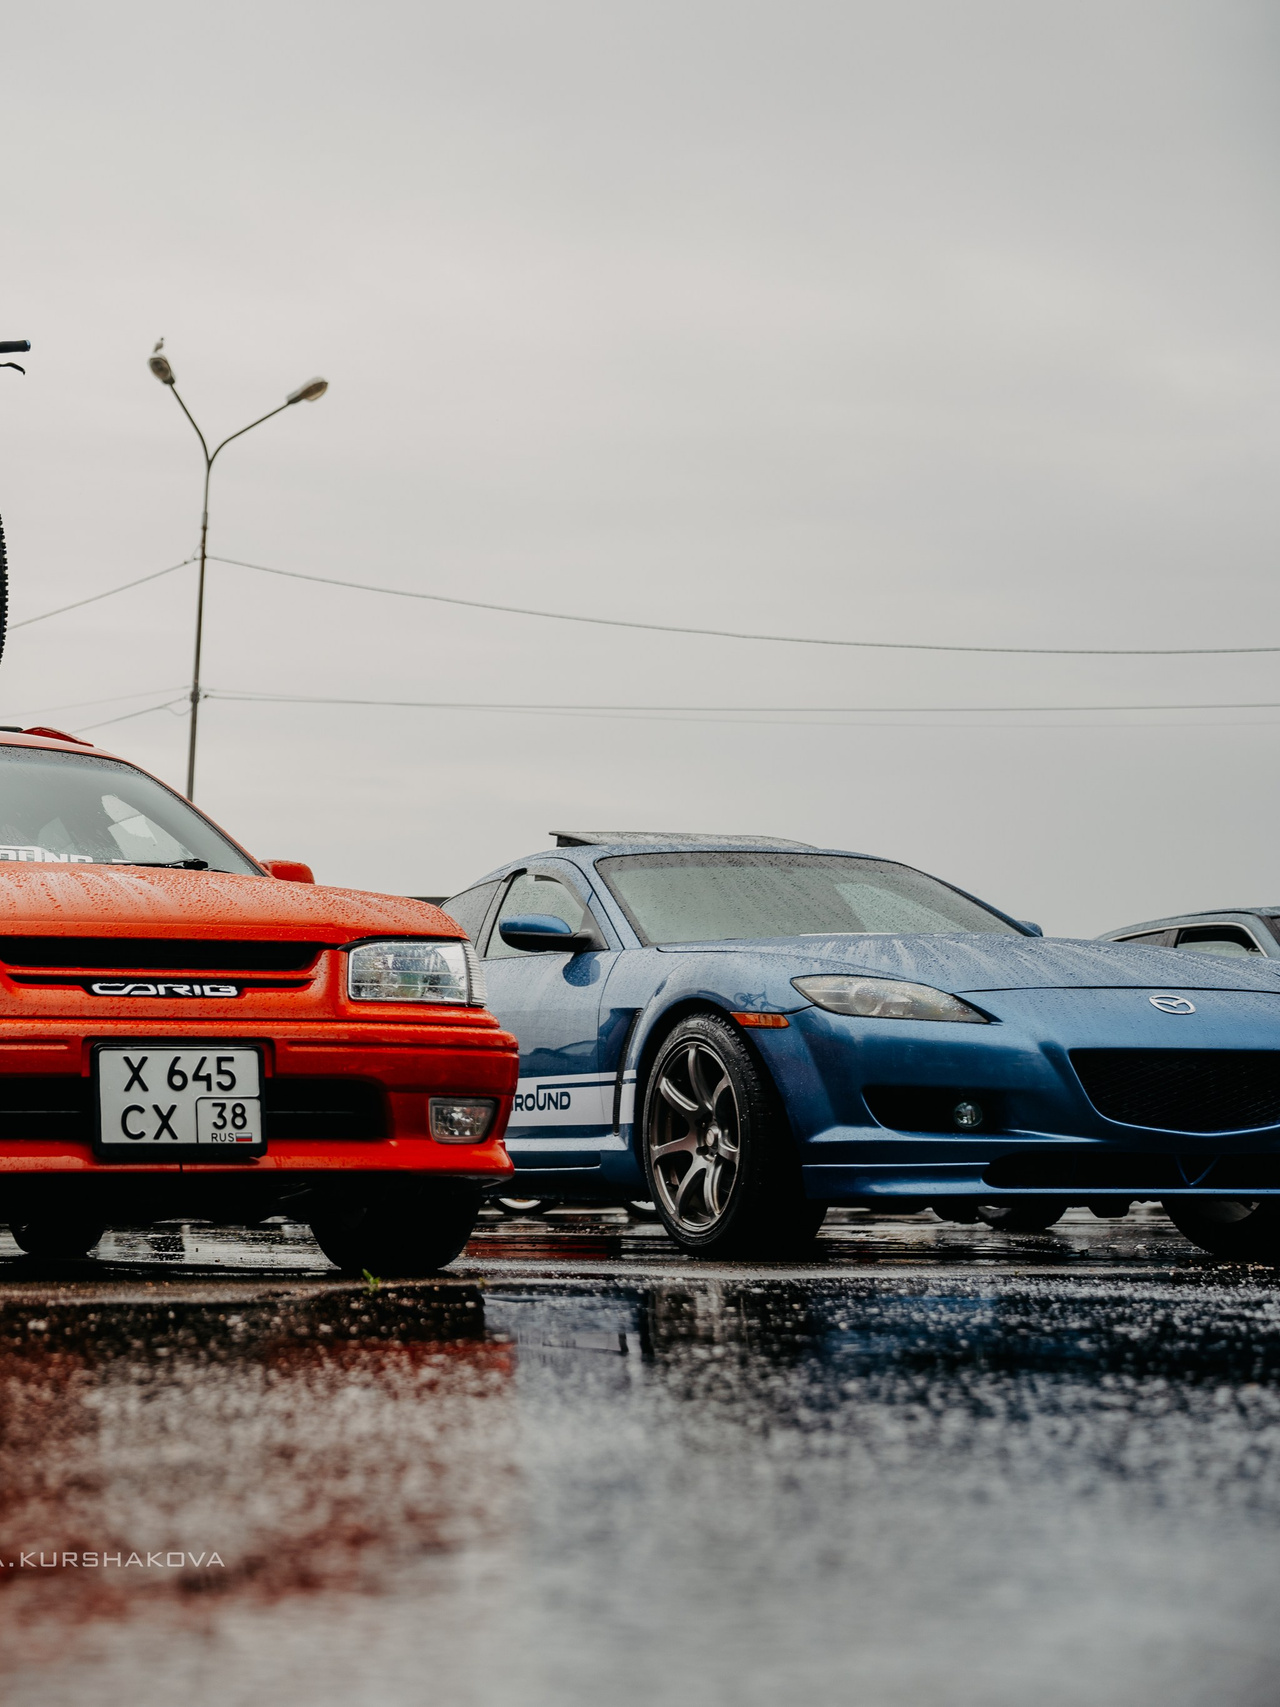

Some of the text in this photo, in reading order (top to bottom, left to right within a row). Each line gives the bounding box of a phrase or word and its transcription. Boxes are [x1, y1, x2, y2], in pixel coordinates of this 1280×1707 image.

[91, 983, 238, 997] CARIB
[122, 1056, 237, 1092] X 645
[511, 1085, 571, 1112] ROUND
[211, 1102, 247, 1130] 38
[210, 1132, 235, 1143] RUS
